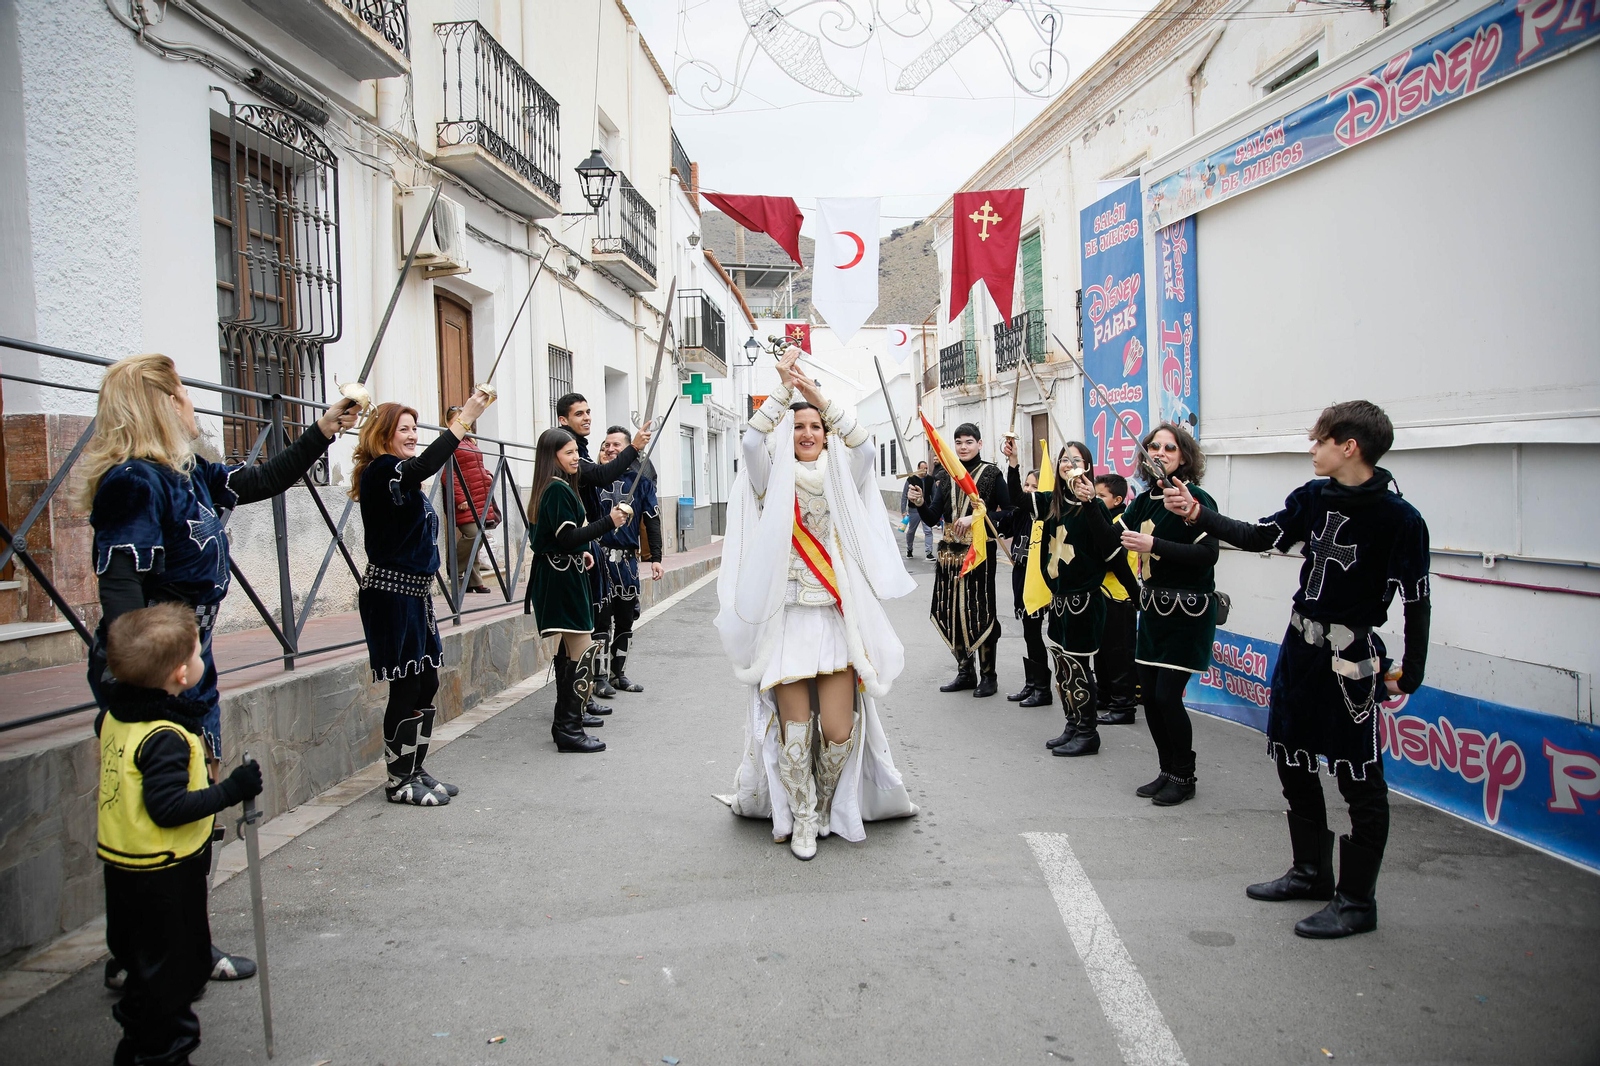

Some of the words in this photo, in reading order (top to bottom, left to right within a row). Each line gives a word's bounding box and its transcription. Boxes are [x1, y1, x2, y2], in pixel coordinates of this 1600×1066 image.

[1220, 171, 1239, 195] DE
[1243, 142, 1304, 185] JUEGOS
[1085, 238, 1098, 259] DE
[1099, 219, 1139, 252] JUEGOS
[1085, 273, 1141, 325] DISNEY
[1093, 303, 1138, 351] PARK
[1089, 389, 1097, 407] 3
[1199, 665, 1223, 689] DE
[1225, 671, 1271, 707] JUEG
